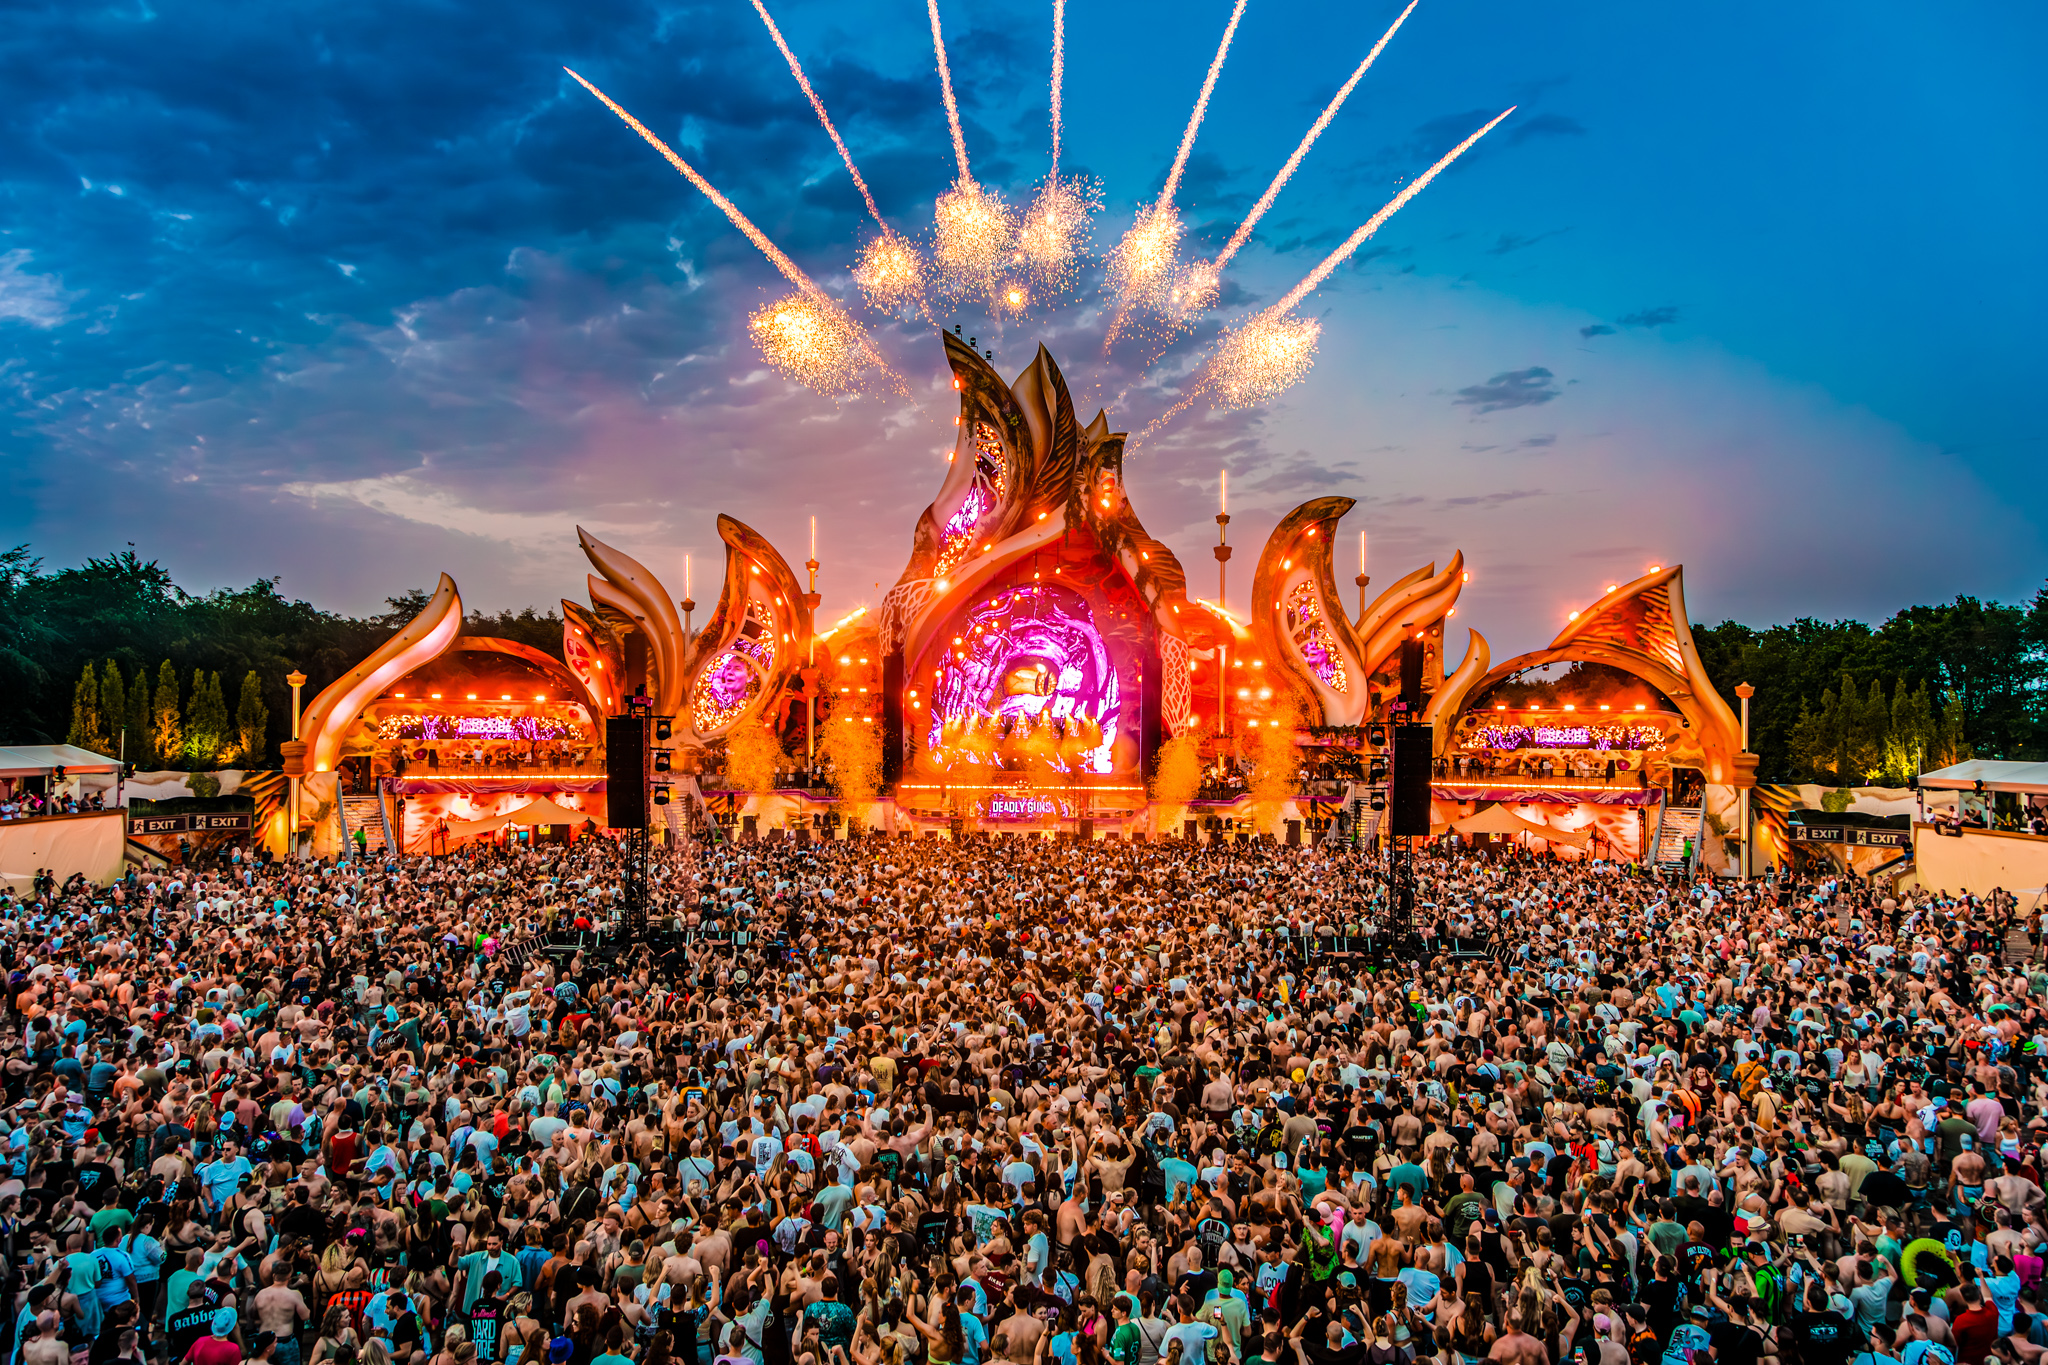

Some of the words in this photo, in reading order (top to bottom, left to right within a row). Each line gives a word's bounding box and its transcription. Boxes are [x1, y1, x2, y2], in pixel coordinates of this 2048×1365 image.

[992, 801, 1025, 813] DEADLY
[1027, 801, 1051, 813] GUNS
[149, 820, 176, 831] EXIT
[211, 817, 239, 827] EXIT
[1811, 829, 1839, 839] EXIT
[1871, 833, 1898, 844] EXIT
[471, 1319, 496, 1340] YARD
